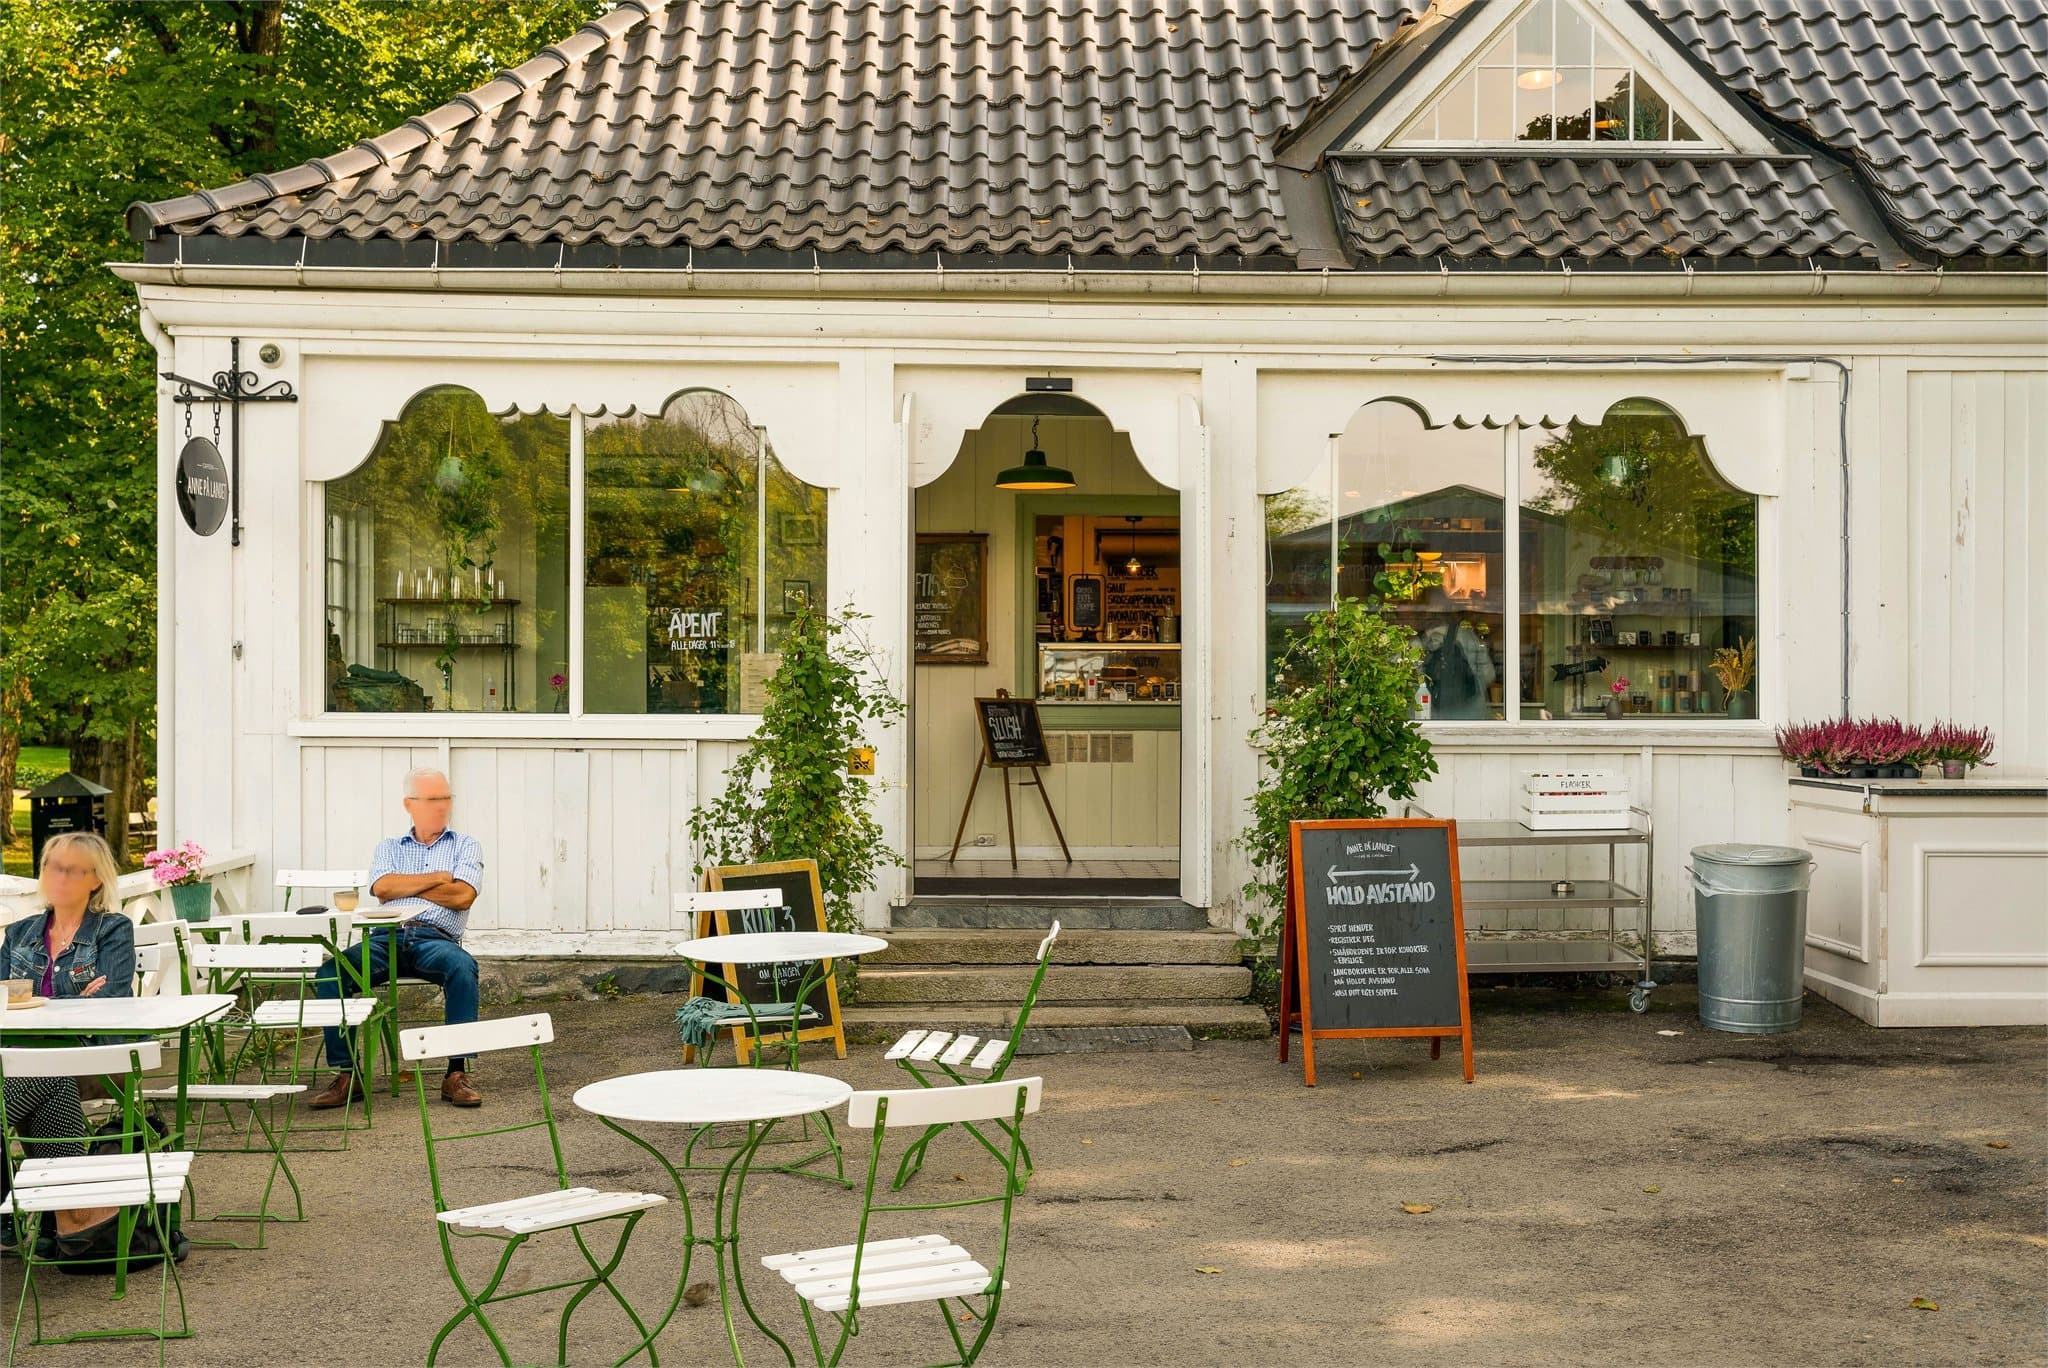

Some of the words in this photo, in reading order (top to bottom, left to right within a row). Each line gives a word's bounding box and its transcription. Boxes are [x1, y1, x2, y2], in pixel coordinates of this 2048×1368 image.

[667, 607, 723, 638] ÅPENT
[671, 640, 688, 652] ALLE
[688, 639, 708, 650] DAGER
[988, 715, 1022, 741] SLUSH
[1346, 842, 1363, 856] ANNE
[1371, 841, 1396, 853] LANDET
[1325, 885, 1365, 905] HOLD
[1366, 881, 1436, 905] AVSTAND
[1329, 924, 1347, 933] SPRIT
[1348, 923, 1374, 933] HENDER
[1414, 967, 1431, 975] SOM
[1345, 977, 1367, 986] HOLDE
[1368, 976, 1396, 985] AVSTAND
